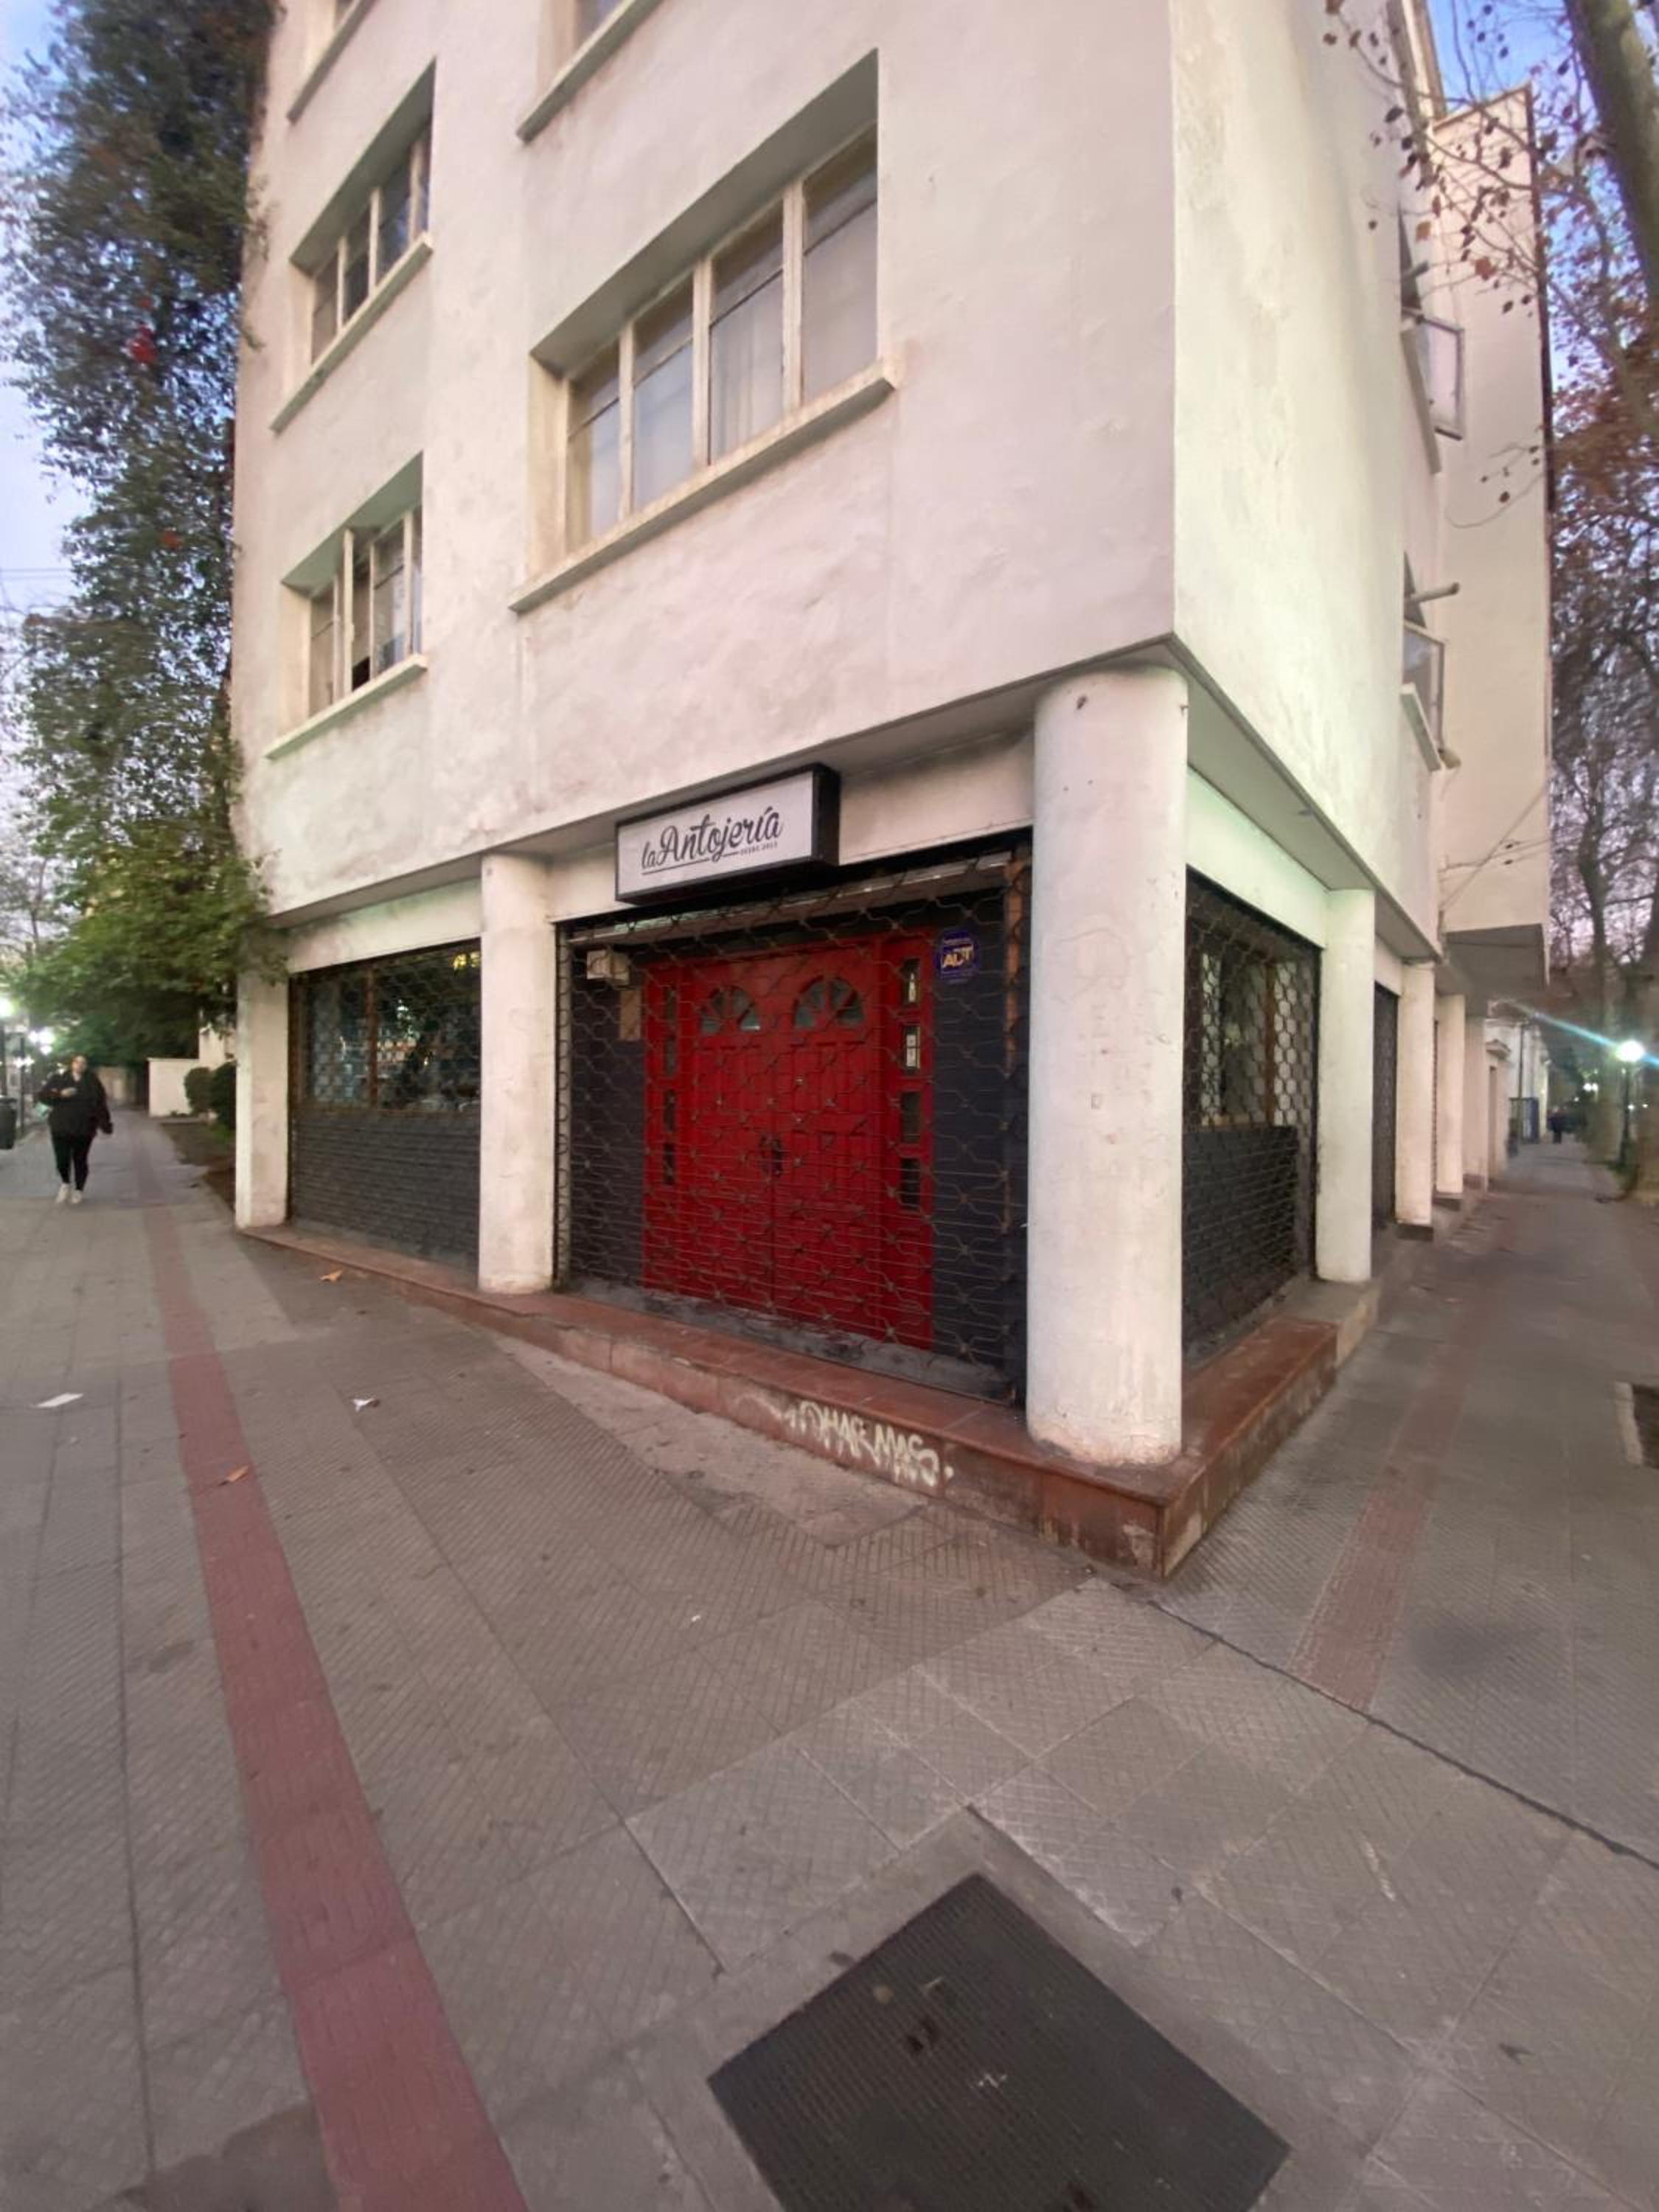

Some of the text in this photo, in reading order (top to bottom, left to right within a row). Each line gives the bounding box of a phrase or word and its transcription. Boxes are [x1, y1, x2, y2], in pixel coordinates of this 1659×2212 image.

[641, 806, 783, 869] la Antojería
[941, 945, 973, 968] ADT
